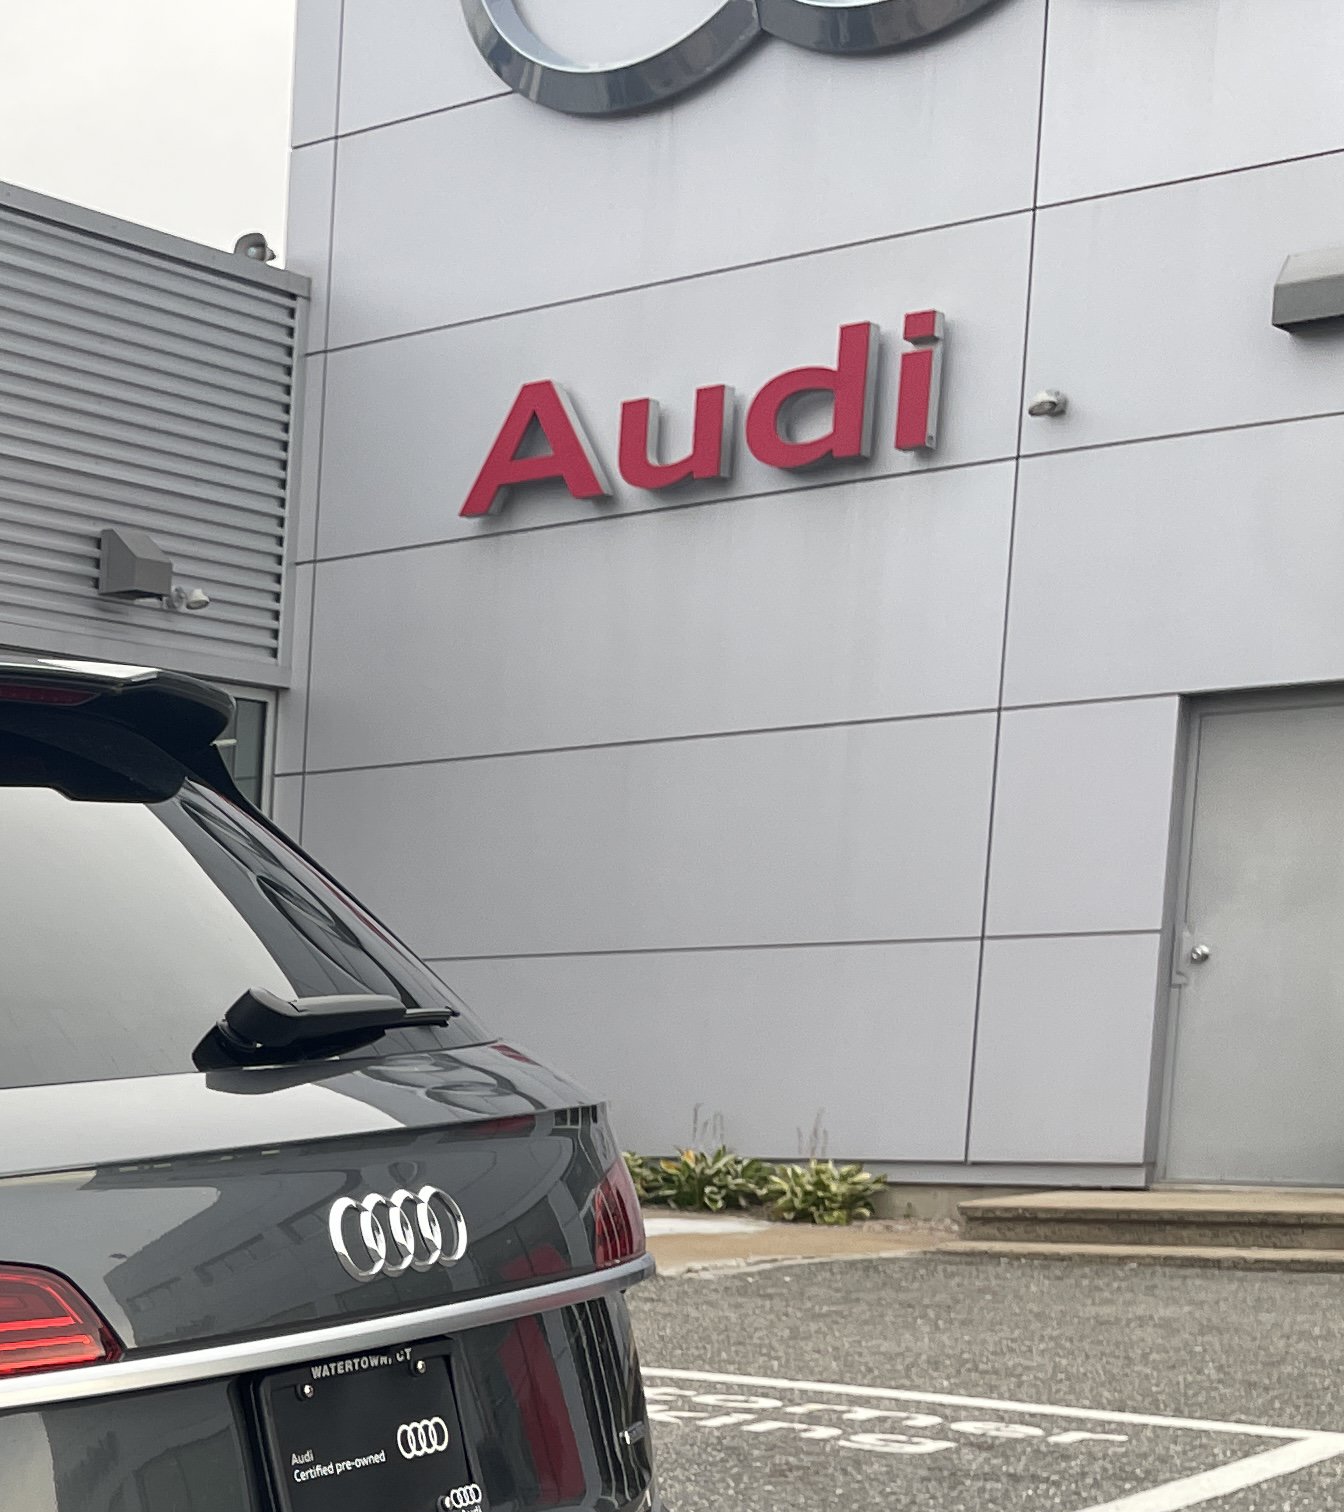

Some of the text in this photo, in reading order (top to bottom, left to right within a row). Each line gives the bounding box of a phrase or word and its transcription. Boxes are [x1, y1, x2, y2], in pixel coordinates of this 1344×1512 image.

[459, 309, 945, 518] Audi
[396, 1347, 412, 1362] CT
[292, 1450, 314, 1466] Audi
[294, 1451, 386, 1483] Certified pre-owned
